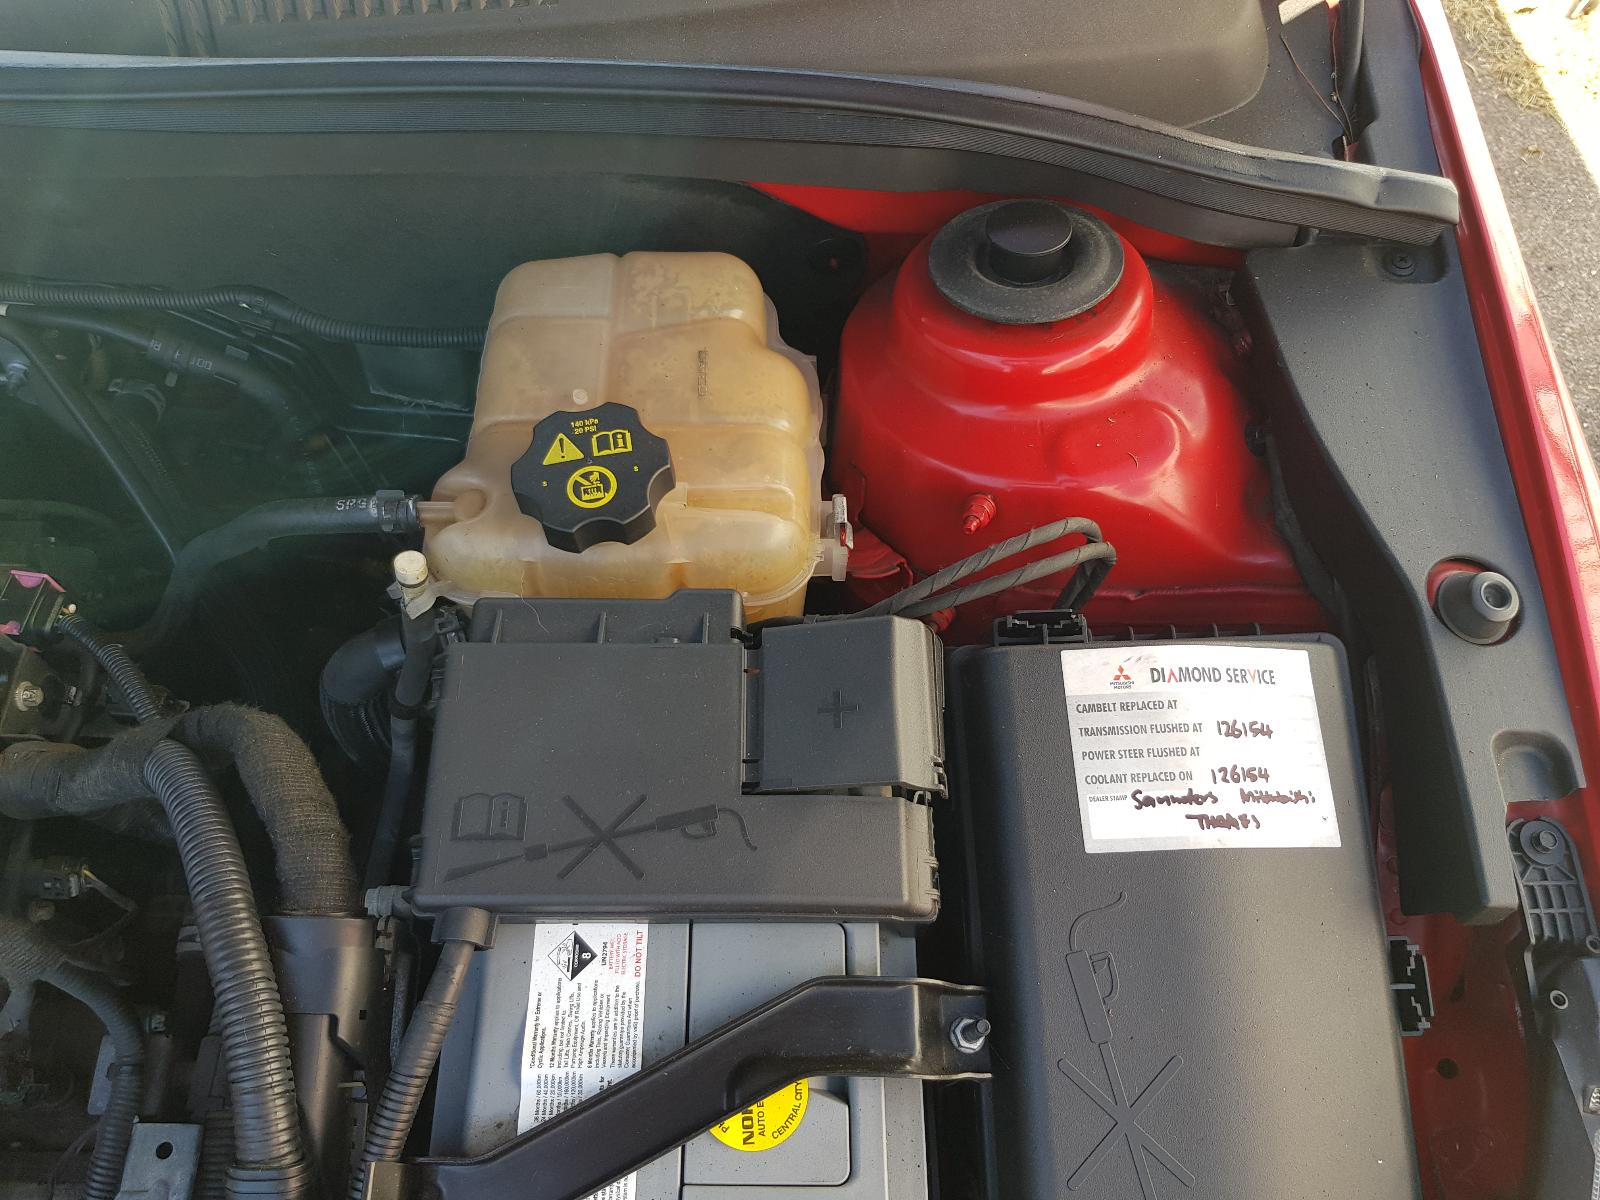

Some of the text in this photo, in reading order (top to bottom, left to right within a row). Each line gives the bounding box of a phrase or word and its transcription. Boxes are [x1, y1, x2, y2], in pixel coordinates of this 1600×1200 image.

[1150, 666, 1276, 685] DIAMOND SERVICE
[1076, 700, 1178, 714] CAMBELT REPLACED AT
[1078, 722, 1202, 737] TRANSMISSION FLUSHED AT
[1216, 720, 1273, 738] 126154
[1082, 746, 1200, 760] POWER STEER FLUSHED AT
[1084, 771, 1192, 785] COOLANT REPLACED ON
[1089, 794, 1128, 803] DEALER STAMP
[635, 966, 641, 977] DO
[757, 1111, 766, 1136] AUTO
[772, 1103, 802, 1139] CENTRAL
